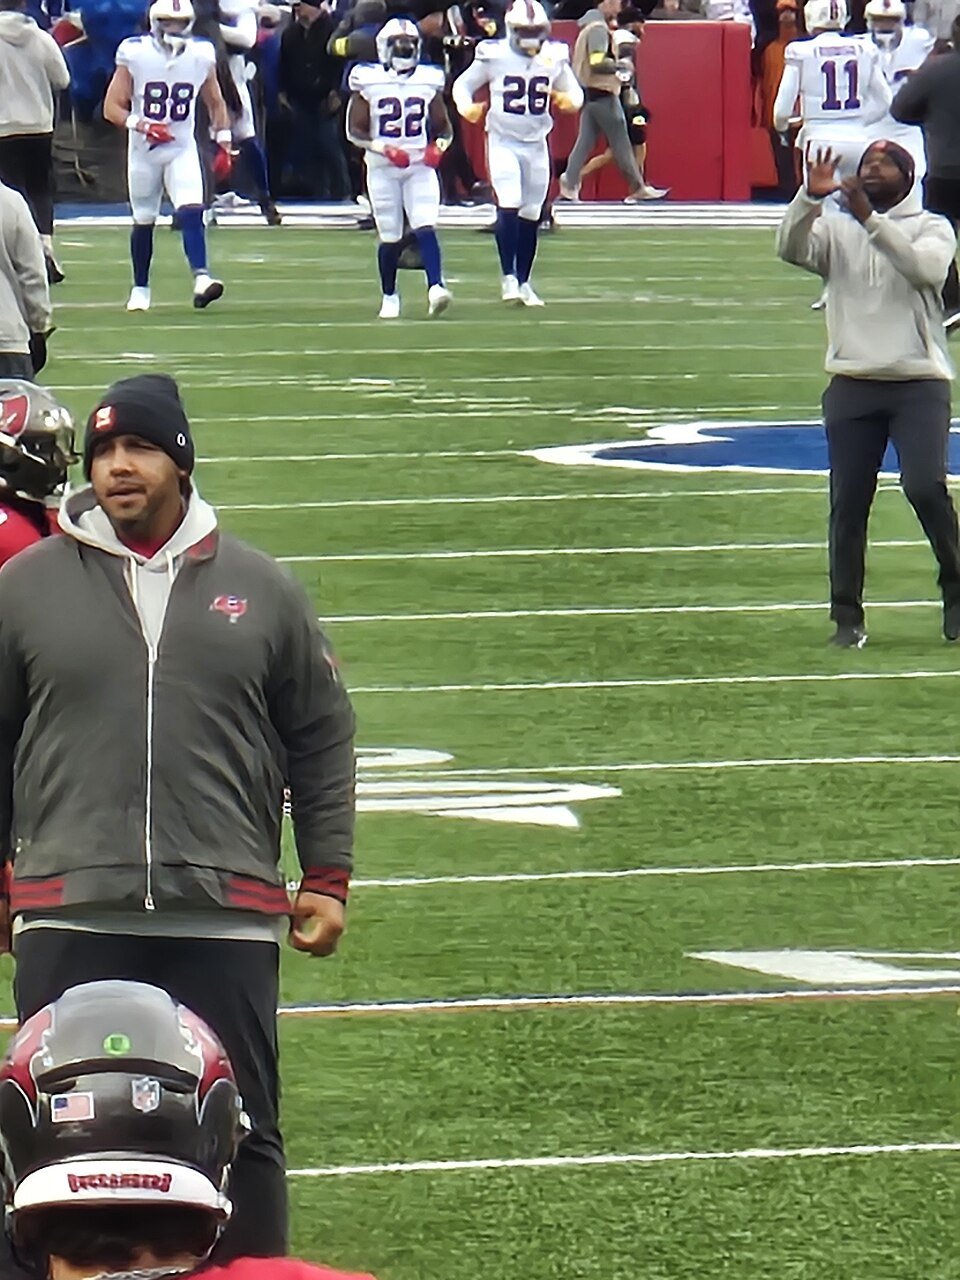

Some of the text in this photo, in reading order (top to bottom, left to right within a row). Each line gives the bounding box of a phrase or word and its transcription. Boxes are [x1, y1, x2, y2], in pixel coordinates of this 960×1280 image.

[143, 81, 195, 121] 88
[503, 75, 550, 116] 26
[821, 60, 861, 111] 11
[378, 97, 426, 138] 22
